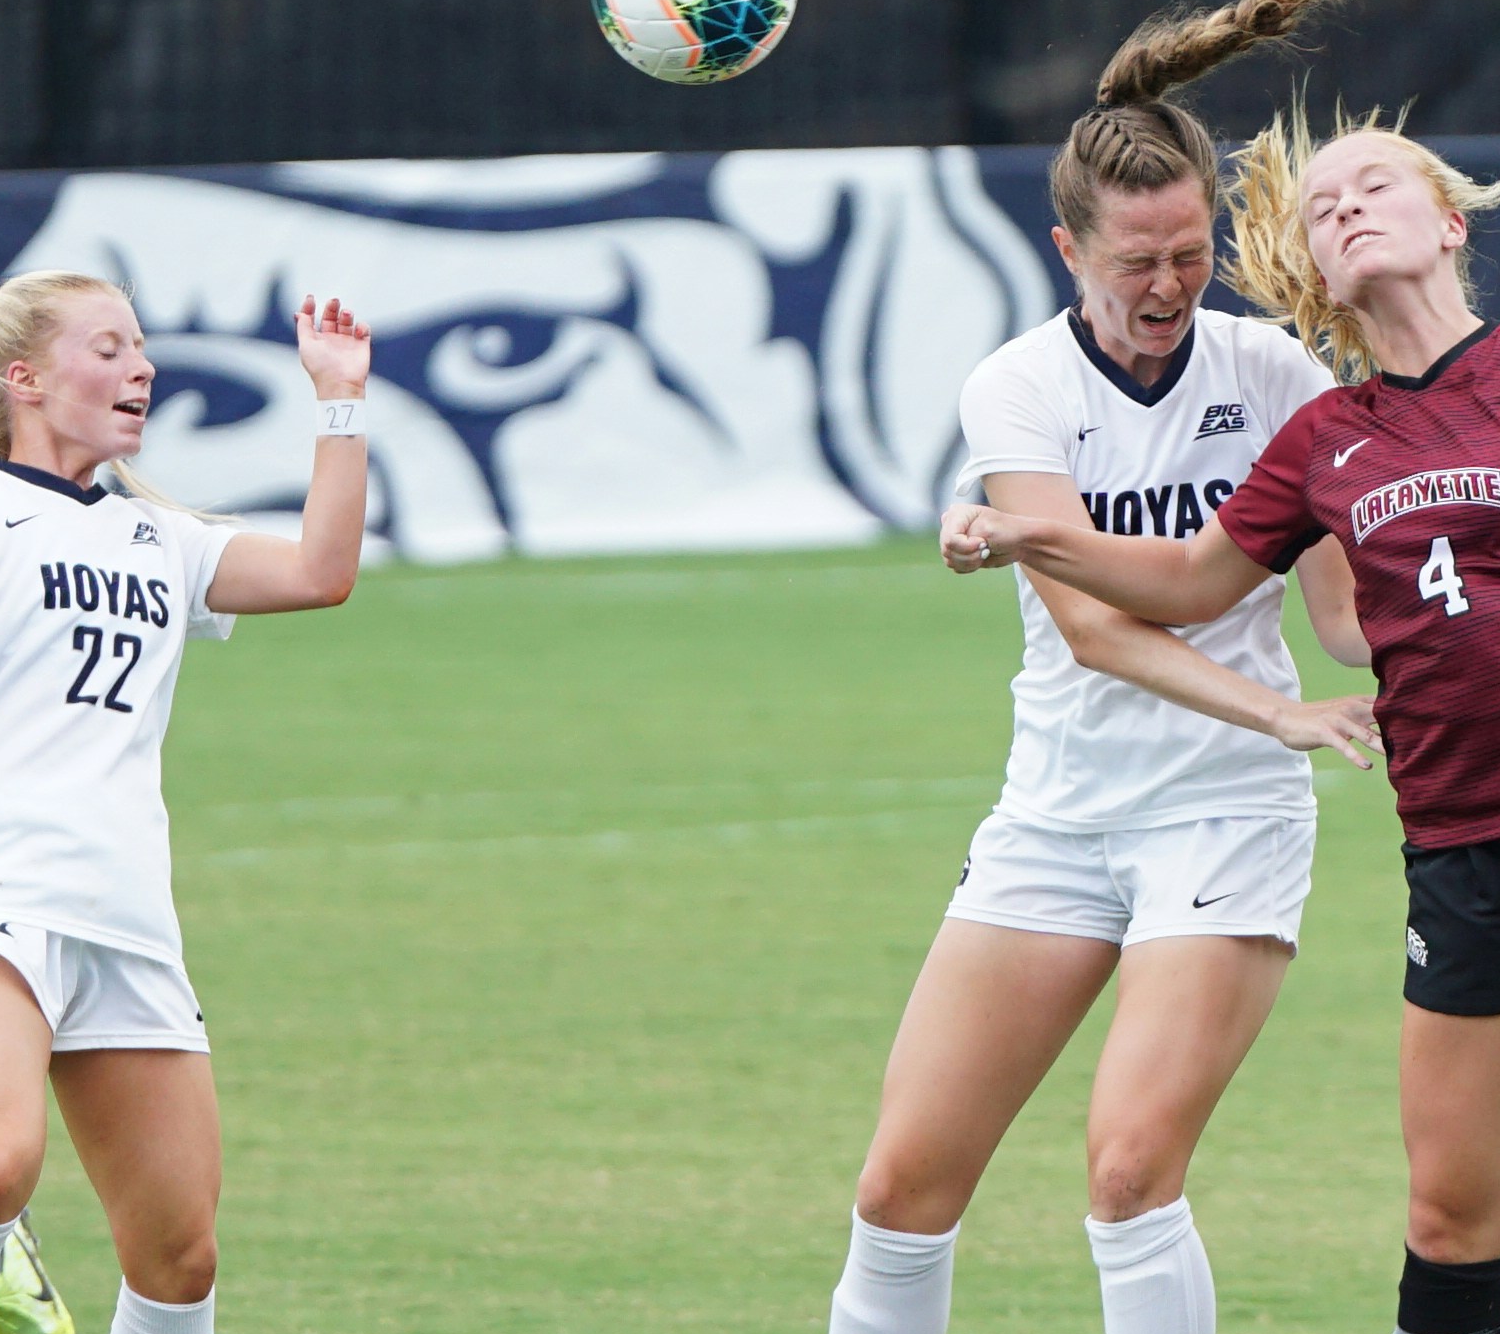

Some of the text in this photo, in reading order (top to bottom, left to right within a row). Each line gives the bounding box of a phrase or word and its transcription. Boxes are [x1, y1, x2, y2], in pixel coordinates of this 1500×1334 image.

[326, 404, 355, 429] 27
[1198, 417, 1248, 433] EAS
[1204, 404, 1244, 418] BIG
[40, 561, 169, 628] HOYAS
[1418, 535, 1471, 617] 4
[66, 625, 142, 713] 22
